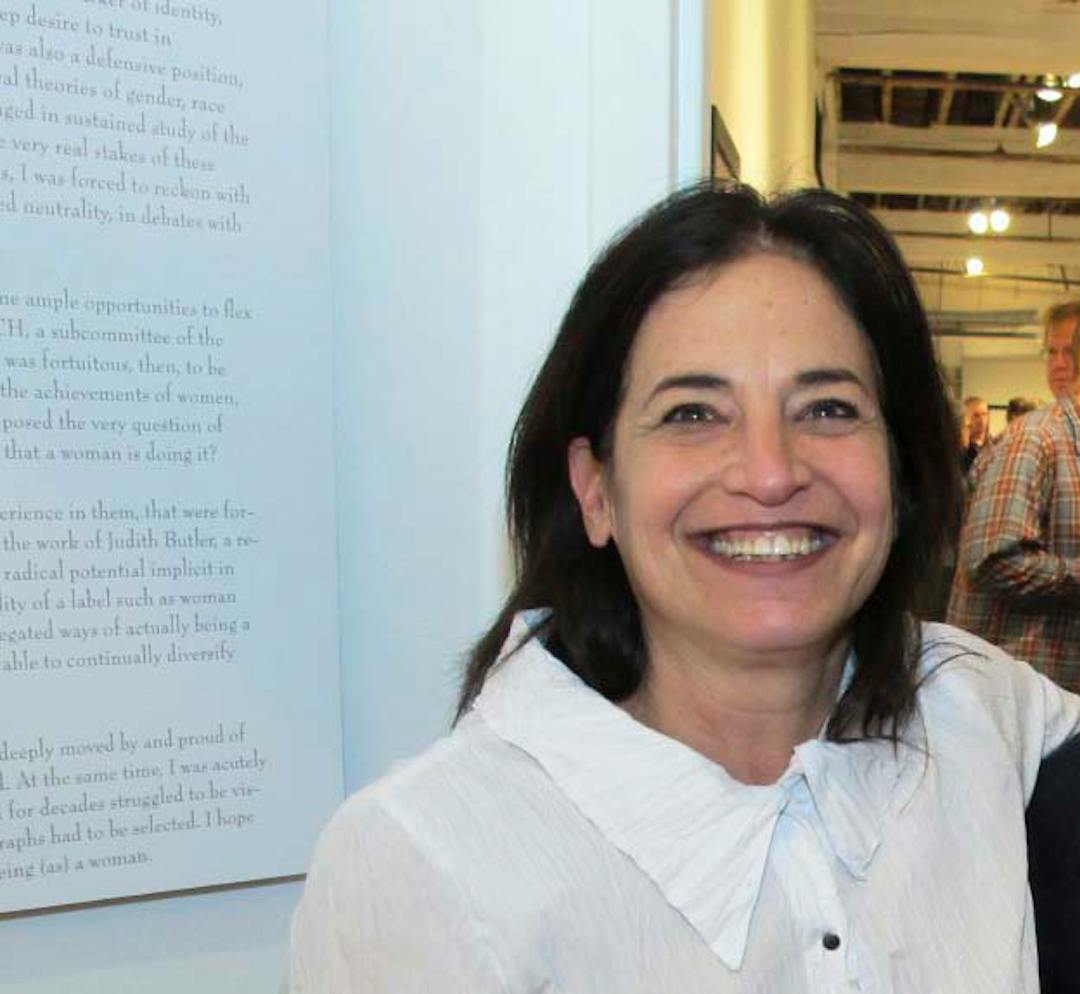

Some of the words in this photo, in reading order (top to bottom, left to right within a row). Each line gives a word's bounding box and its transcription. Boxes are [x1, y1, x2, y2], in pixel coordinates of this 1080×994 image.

[0, 11, 20, 27] ep
[27, 3, 79, 32] desire
[86, 17, 103, 36] to
[109, 22, 149, 42] trust
[154, 27, 172, 46] in
[28, 36, 65, 63] also
[70, 52, 80, 65] a
[86, 44, 166, 75] defensive
[172, 64, 244, 90] position,
[25, 67, 97, 98] theories
[103, 76, 120, 100] of
[126, 83, 186, 111] gender,
[192, 99, 225, 114] race
[41, 104, 58, 123] in
[64, 111, 146, 134] sustained
[152, 116, 197, 142] study
[201, 122, 218, 142] of
[225, 124, 249, 146] the
[12, 138, 49, 157] very
[56, 136, 87, 157] real
[95, 140, 146, 164] stakes
[151, 145, 168, 167] of
[174, 146, 216, 172] these
[20, 163, 27, 182] I
[34, 170, 66, 186] was
[71, 165, 126, 192] forced
[132, 178, 149, 194] to
[155, 176, 211, 200] reckon
[216, 182, 250, 205] with
[23, 198, 112, 225] neutrality,
[118, 203, 136, 223] in
[141, 203, 201, 229] debates
[208, 211, 242, 233] with
[25, 287, 79, 313] ample
[84, 297, 197, 316] opportunities
[203, 304, 219, 318] to
[224, 297, 252, 320] flex
[35, 327, 45, 339] a
[51, 318, 171, 345] subcommittee
[175, 325, 194, 346] of
[199, 325, 223, 347] the
[4, 355, 36, 369] was
[42, 347, 133, 373] fortuitous,
[139, 351, 180, 376] then,
[186, 360, 202, 376] to
[208, 354, 226, 377] be
[1, 376, 28, 400] the
[33, 378, 149, 403] achievements
[155, 382, 172, 404] of
[177, 391, 239, 407] women,
[3, 407, 52, 434] posed
[59, 409, 86, 431] the
[91, 418, 126, 438] very
[131, 412, 202, 437] question
[207, 414, 223, 434] of
[5, 438, 39, 460] that
[45, 448, 56, 460] a
[61, 448, 121, 461] woman
[127, 445, 141, 461] is
[146, 443, 192, 465] doing
[196, 443, 217, 463] it?
[69, 502, 86, 520] in
[91, 498, 139, 523] them,
[145, 498, 177, 520] that
[182, 506, 218, 520] were
[224, 499, 255, 519] for-
[3, 529, 31, 552] the
[36, 528, 80, 550] work
[84, 528, 102, 550] of
[108, 527, 158, 552] Judith
[165, 527, 218, 549] Butler,
[224, 537, 233, 548] a
[237, 536, 259, 548] re-
[4, 558, 64, 581] radical
[70, 556, 145, 584] potential
[151, 555, 212, 580] implicit
[218, 561, 234, 577] in
[32, 587, 51, 611] of
[56, 598, 66, 610] a
[71, 586, 110, 610] label
[116, 586, 153, 608] such
[158, 595, 174, 607] as
[180, 592, 236, 605] woman
[59, 626, 98, 644] ways
[103, 614, 121, 638] of
[125, 612, 190, 638] actually
[195, 612, 237, 635] being
[241, 618, 250, 632] a
[2, 650, 39, 672] able
[45, 655, 62, 669] to
[66, 642, 162, 669] continually
[167, 640, 235, 664] diversify
[60, 732, 115, 757] moved
[120, 730, 138, 755] by
[144, 727, 173, 750] and
[178, 723, 223, 750] proud
[228, 720, 246, 743] of
[16, 769, 37, 790] At
[42, 765, 70, 788] the
[75, 772, 118, 786] same
[122, 765, 163, 782] time,
[169, 758, 175, 776] I
[181, 761, 208, 774] was
[212, 747, 267, 772] acutely
[9, 798, 34, 819] for
[39, 792, 105, 817] decades
[110, 783, 183, 810] struggled
[189, 787, 205, 802] to
[209, 778, 228, 800] be
[232, 780, 262, 798] vis-
[50, 822, 81, 845] had
[87, 825, 104, 842] to
[109, 818, 128, 839] be
[131, 808, 200, 836] selected.
[206, 810, 212, 829] I
[217, 807, 255, 831] hope
[40, 853, 69, 876] (as)
[74, 859, 85, 872] a
[89, 852, 153, 869] woman.
